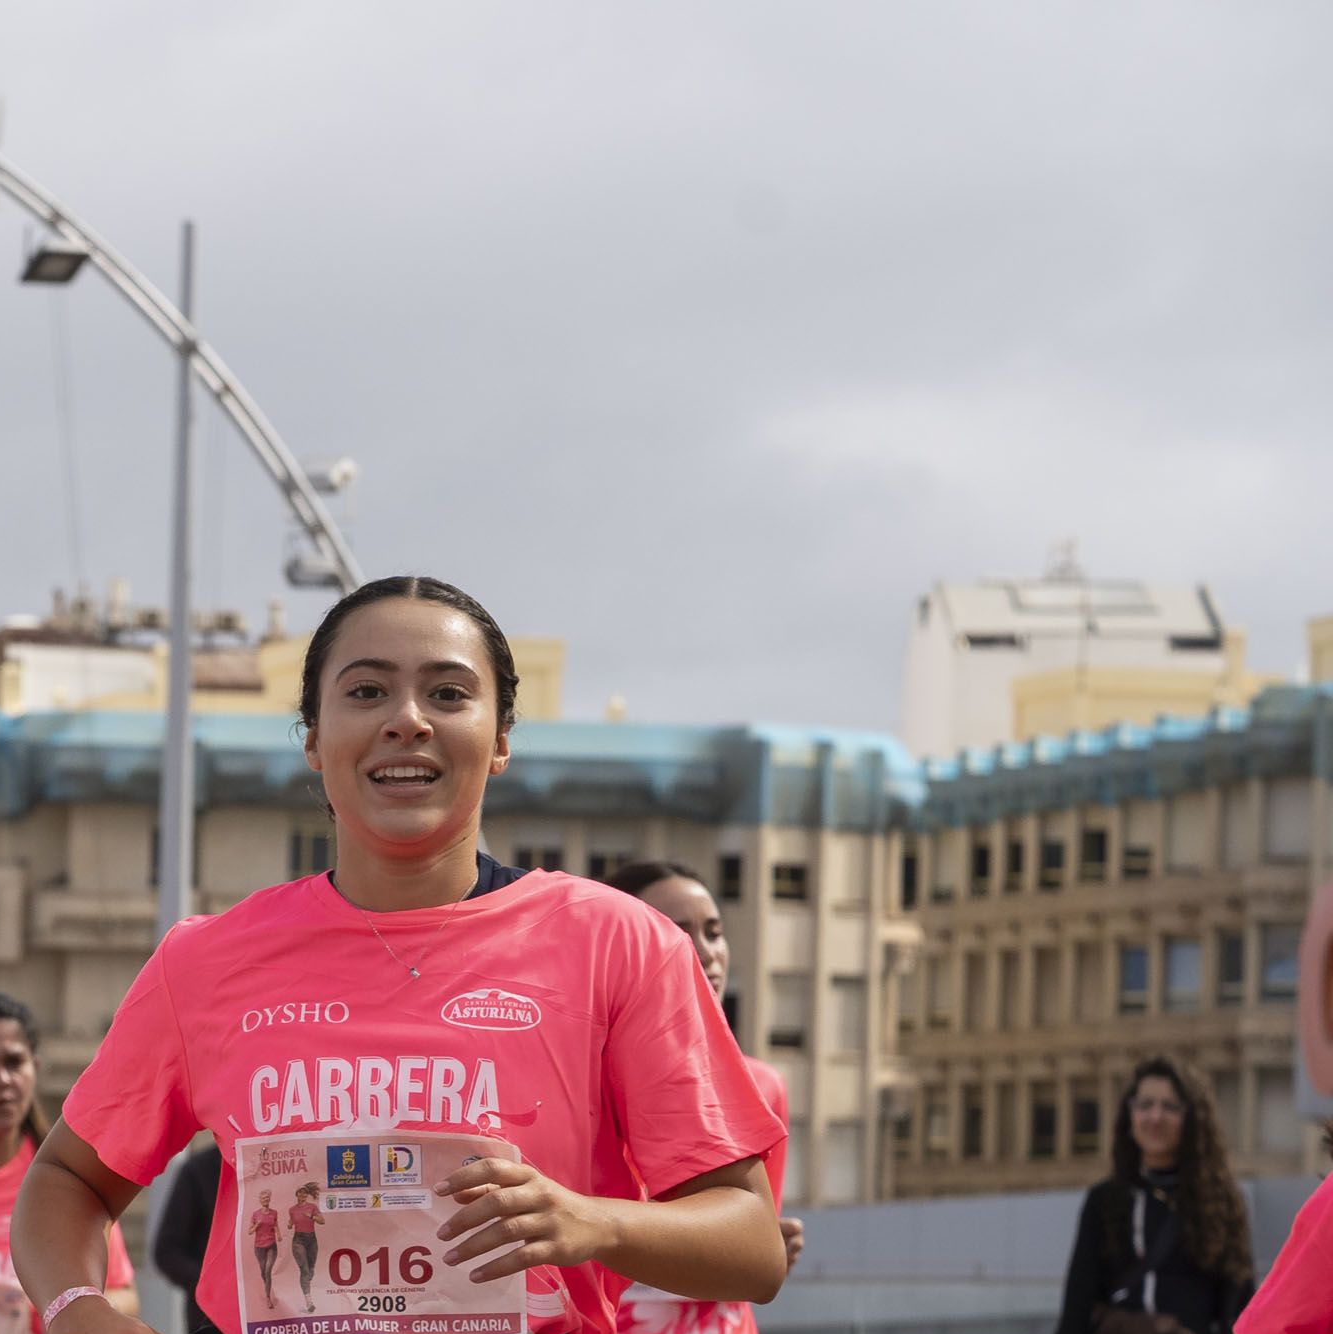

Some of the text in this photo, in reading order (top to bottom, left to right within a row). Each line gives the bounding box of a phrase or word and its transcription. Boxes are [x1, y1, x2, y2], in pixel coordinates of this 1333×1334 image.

[242, 1001, 349, 1032] OYSHO
[449, 1002, 533, 1024] ASTURIANA
[250, 1056, 501, 1133] CARRERA
[271, 1149, 307, 1160] DORSAL
[261, 1158, 309, 1176] SUMA
[328, 1245, 434, 1287] 016
[357, 1295, 406, 1312] 2908
[312, 1321, 330, 1334] DE
[334, 1320, 351, 1333] LA
[355, 1319, 399, 1333] MUJER
[411, 1320, 448, 1333] GRAN
[452, 1319, 511, 1333] CANARIA
